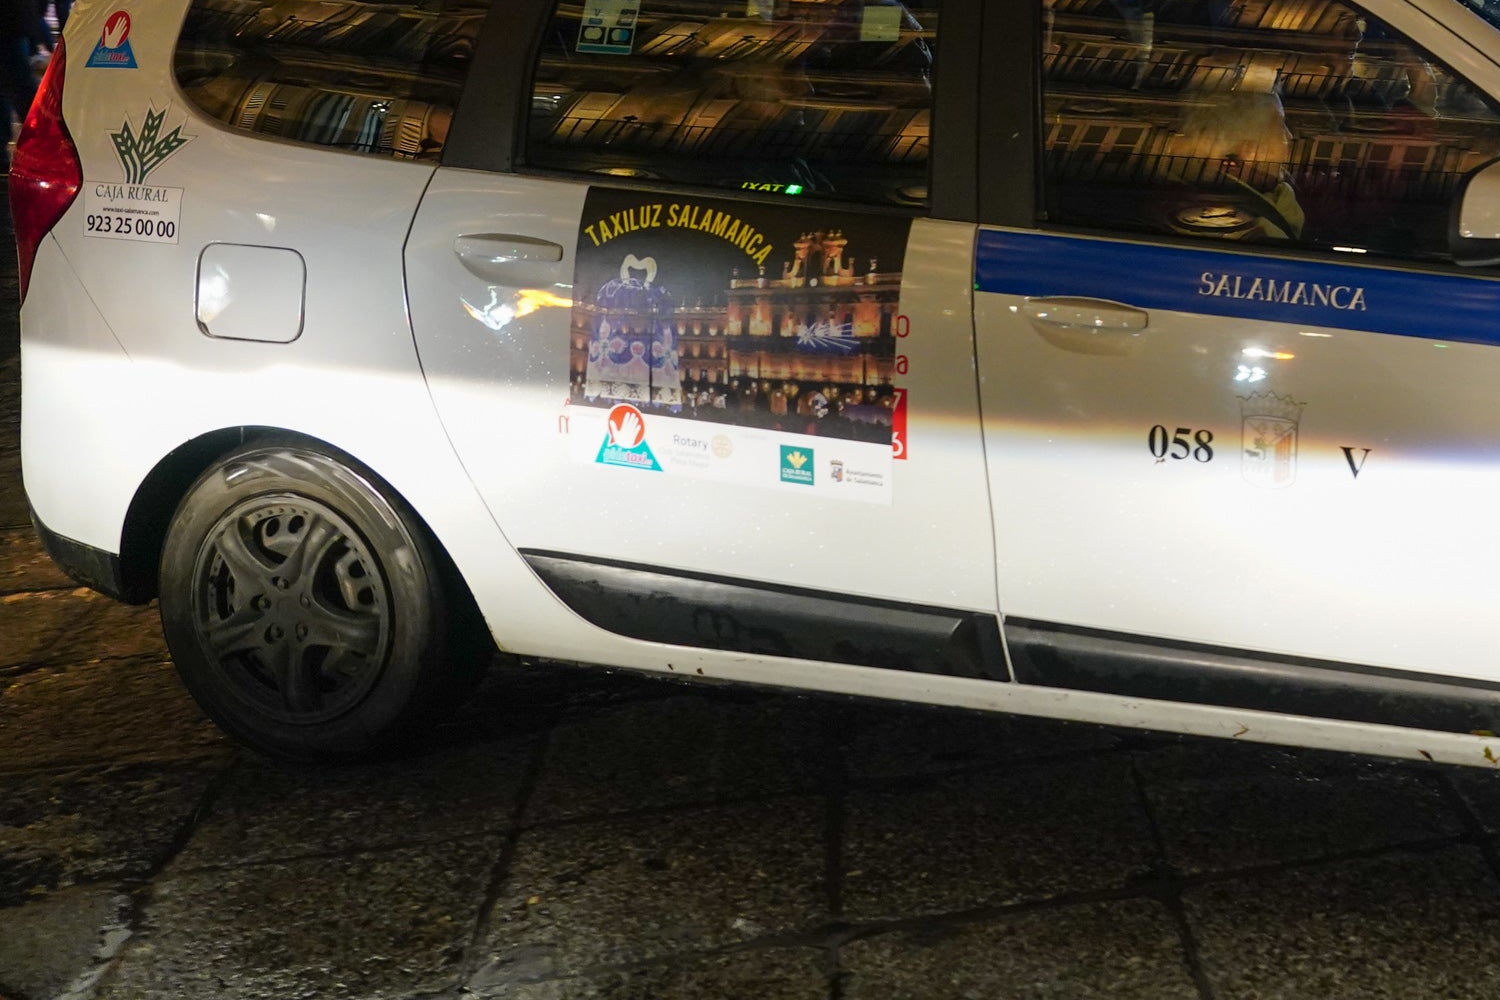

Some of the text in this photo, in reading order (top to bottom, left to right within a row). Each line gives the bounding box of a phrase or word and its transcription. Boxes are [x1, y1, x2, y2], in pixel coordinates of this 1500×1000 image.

[95, 184, 169, 203] CAJA RURAL
[87, 214, 175, 238] 923 25 00 00
[585, 203, 774, 266] TAXILUZ SALAMANCA
[1199, 271, 1368, 312] SALAMANCA
[673, 434, 709, 450] Rotary
[1148, 424, 1372, 480] 058 V
